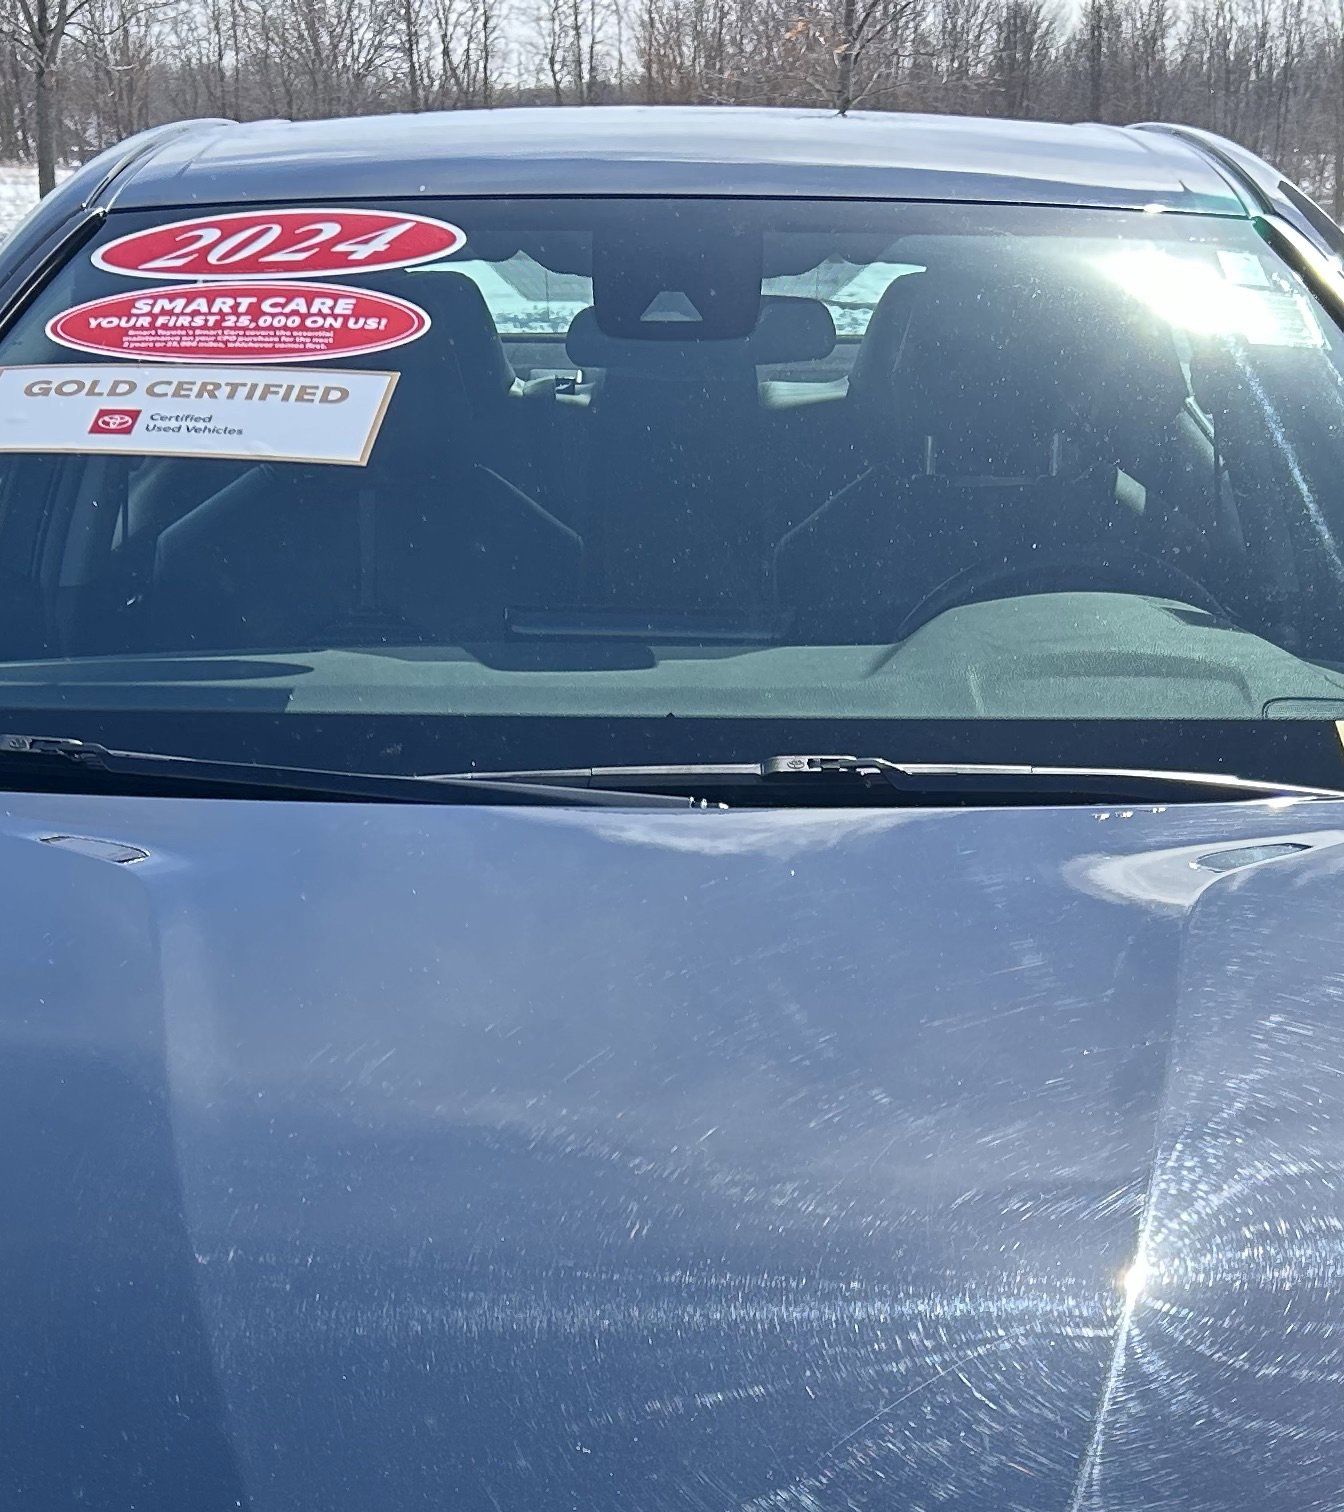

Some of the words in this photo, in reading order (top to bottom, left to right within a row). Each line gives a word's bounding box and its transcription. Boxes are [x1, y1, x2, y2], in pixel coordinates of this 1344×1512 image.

[137, 221, 417, 270] 2024
[130, 296, 257, 315] SMART
[260, 296, 357, 315] CARE
[88, 315, 152, 329] YOUR
[154, 315, 221, 328] FIRST
[221, 315, 302, 329] 25,000
[304, 316, 344, 329] ON
[347, 317, 388, 331] US!
[23, 379, 138, 398] GOLD
[145, 380, 351, 405] CERTIFIED
[149, 412, 213, 423] Certified
[145, 423, 183, 433] Used
[186, 425, 244, 435] Vehicles
